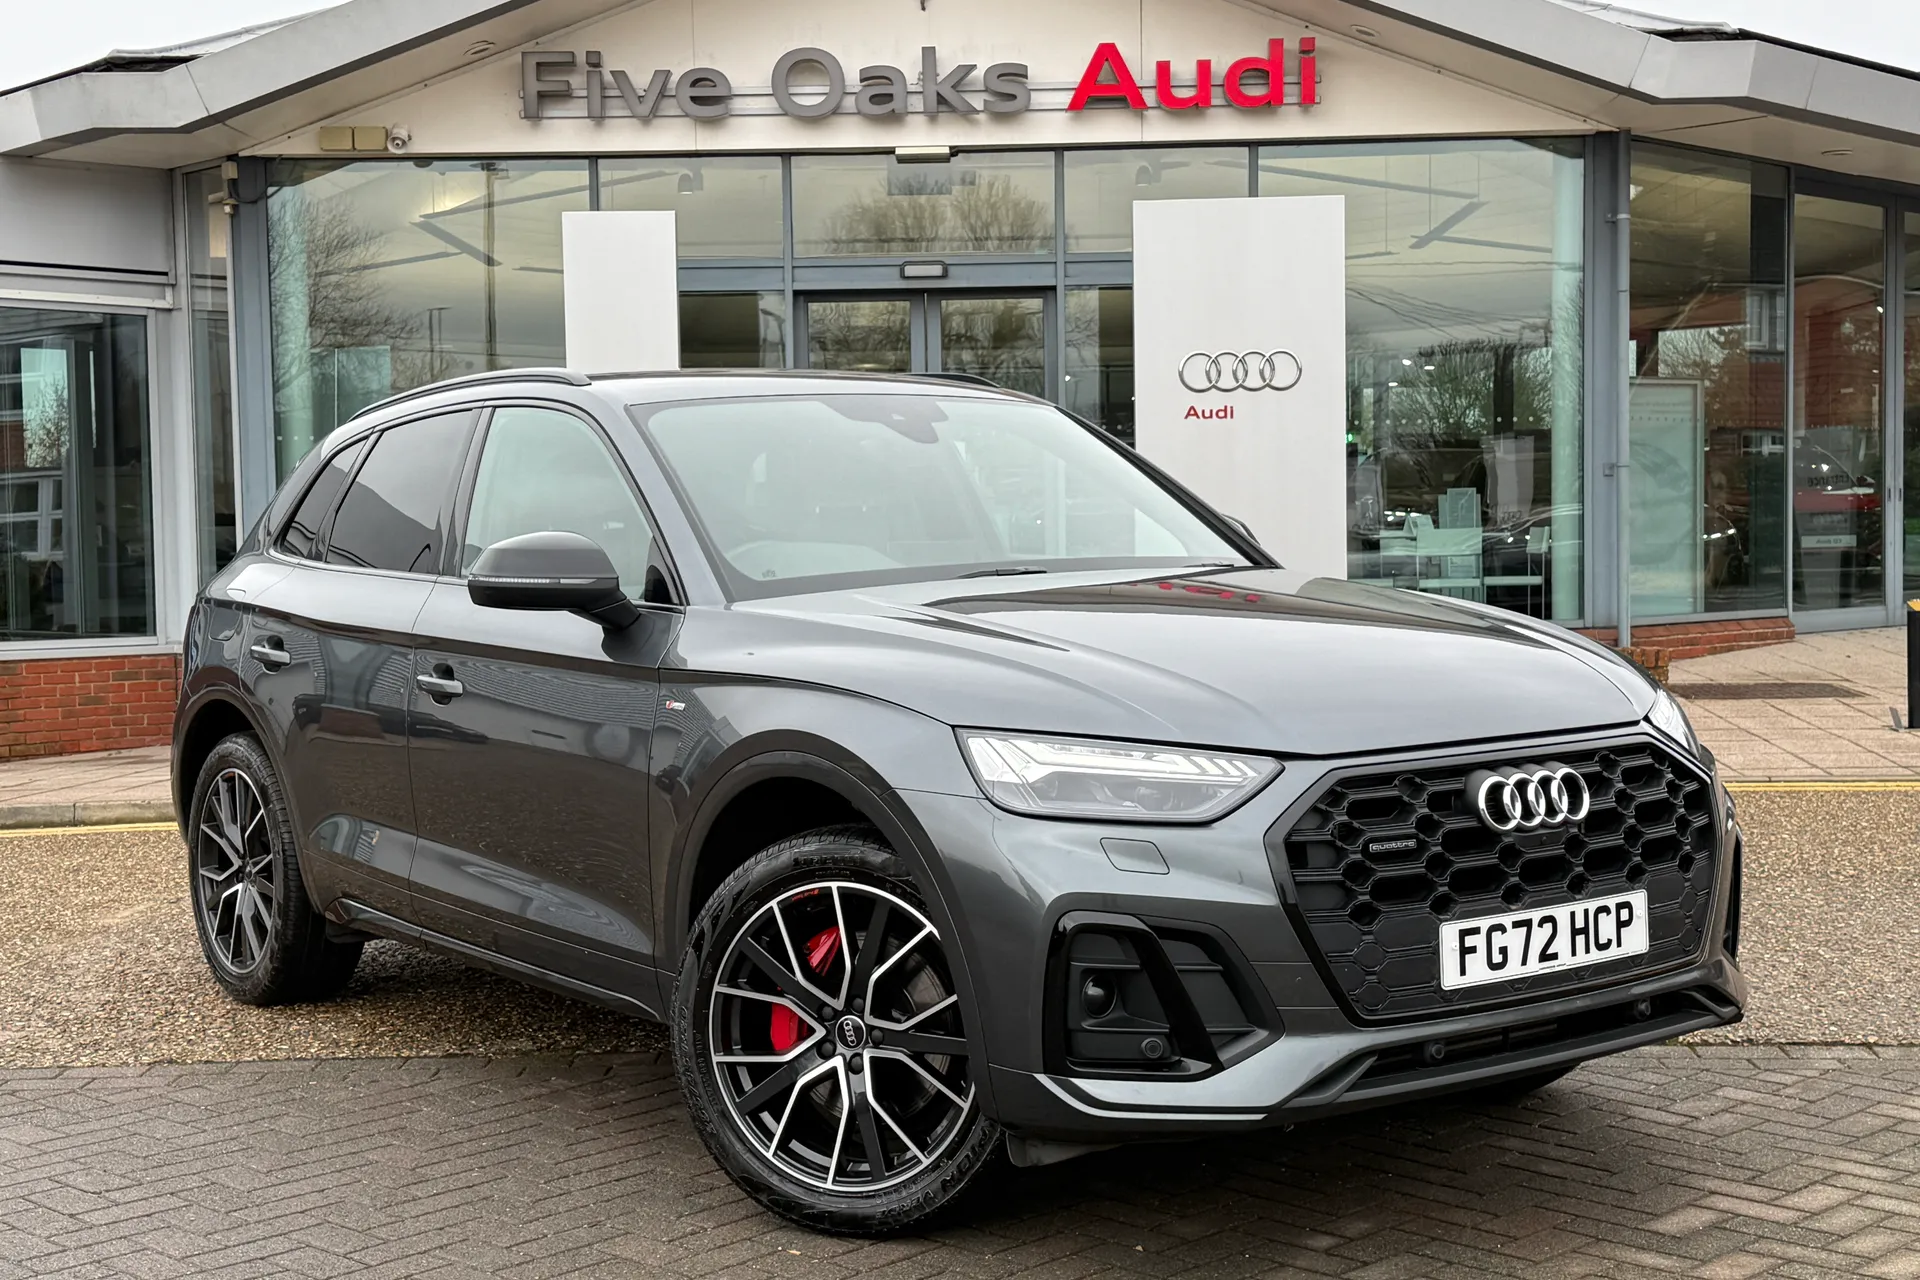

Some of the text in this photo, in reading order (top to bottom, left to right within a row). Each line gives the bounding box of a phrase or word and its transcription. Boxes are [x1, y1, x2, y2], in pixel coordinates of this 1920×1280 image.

[521, 37, 1316, 120] Five Oaks Audi
[1184, 405, 1234, 420] Audi
[1372, 841, 1415, 852] quattro
[1458, 900, 1634, 977] FG72 HCP
